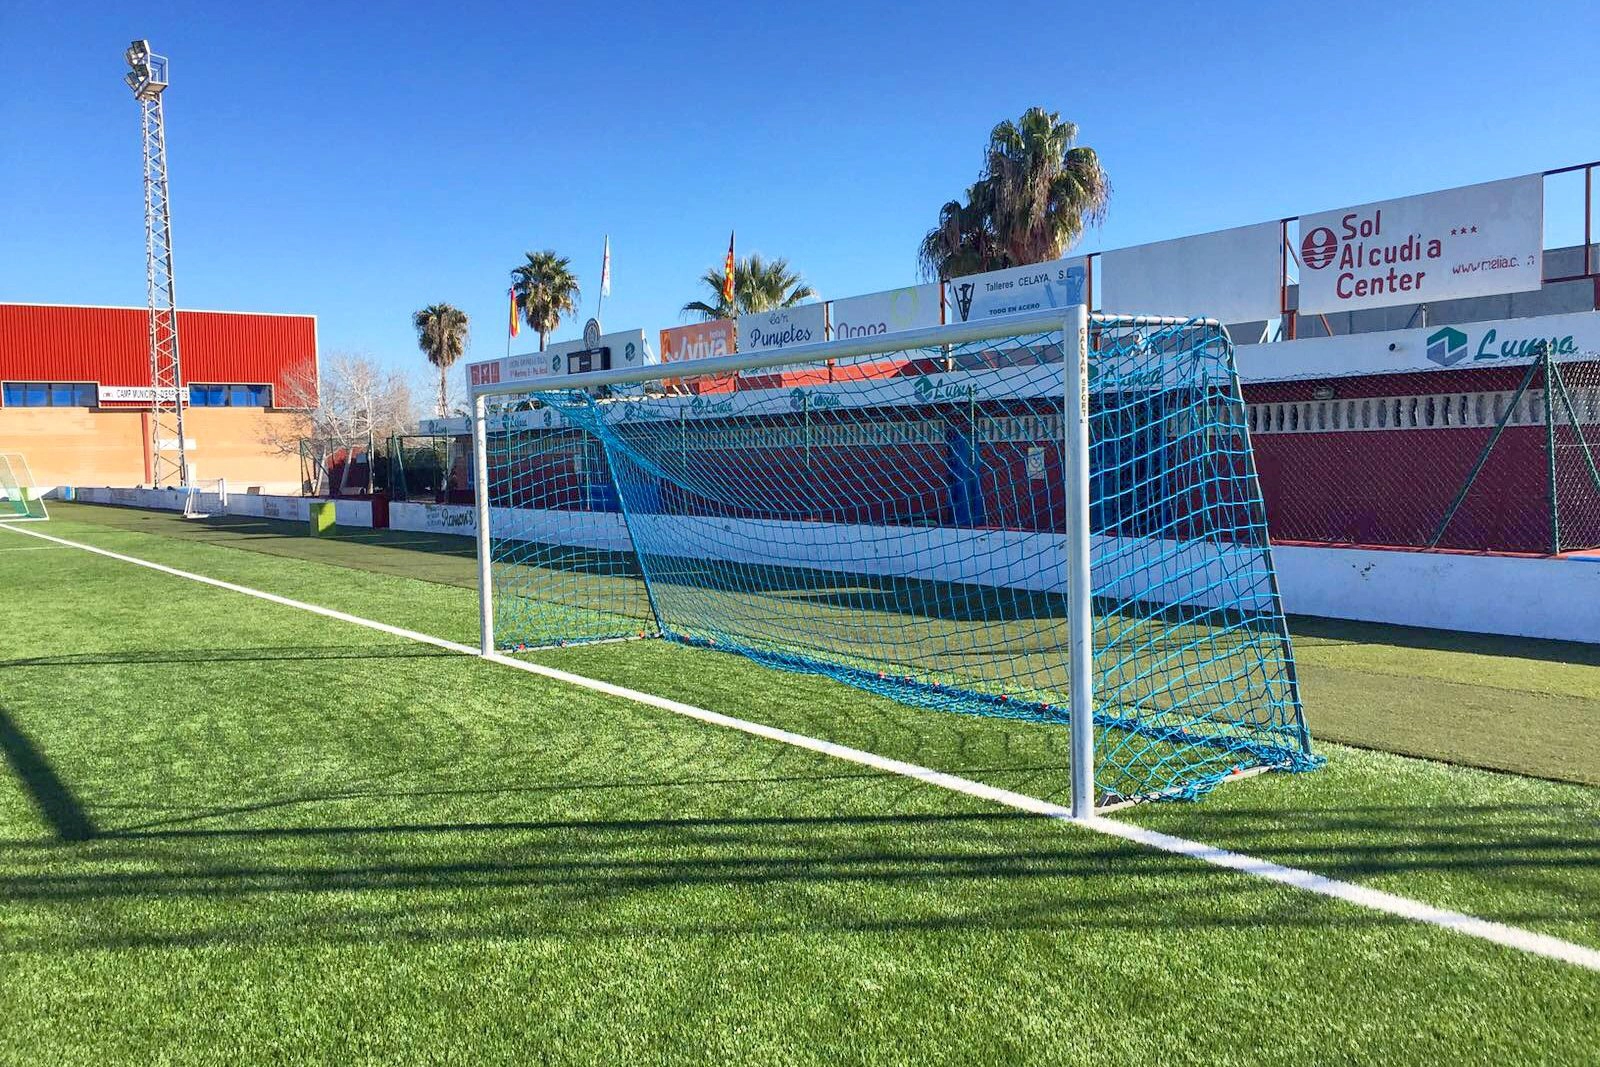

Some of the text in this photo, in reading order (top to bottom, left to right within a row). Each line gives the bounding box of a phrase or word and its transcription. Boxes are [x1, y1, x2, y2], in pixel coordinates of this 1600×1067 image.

[1341, 209, 1381, 241] Sol
[985, 281, 1014, 293] Talleres
[1336, 267, 1426, 299] Center
[1007, 305, 1017, 313] EN
[1018, 302, 1040, 311] ACERO
[750, 324, 812, 348] Punyetes
